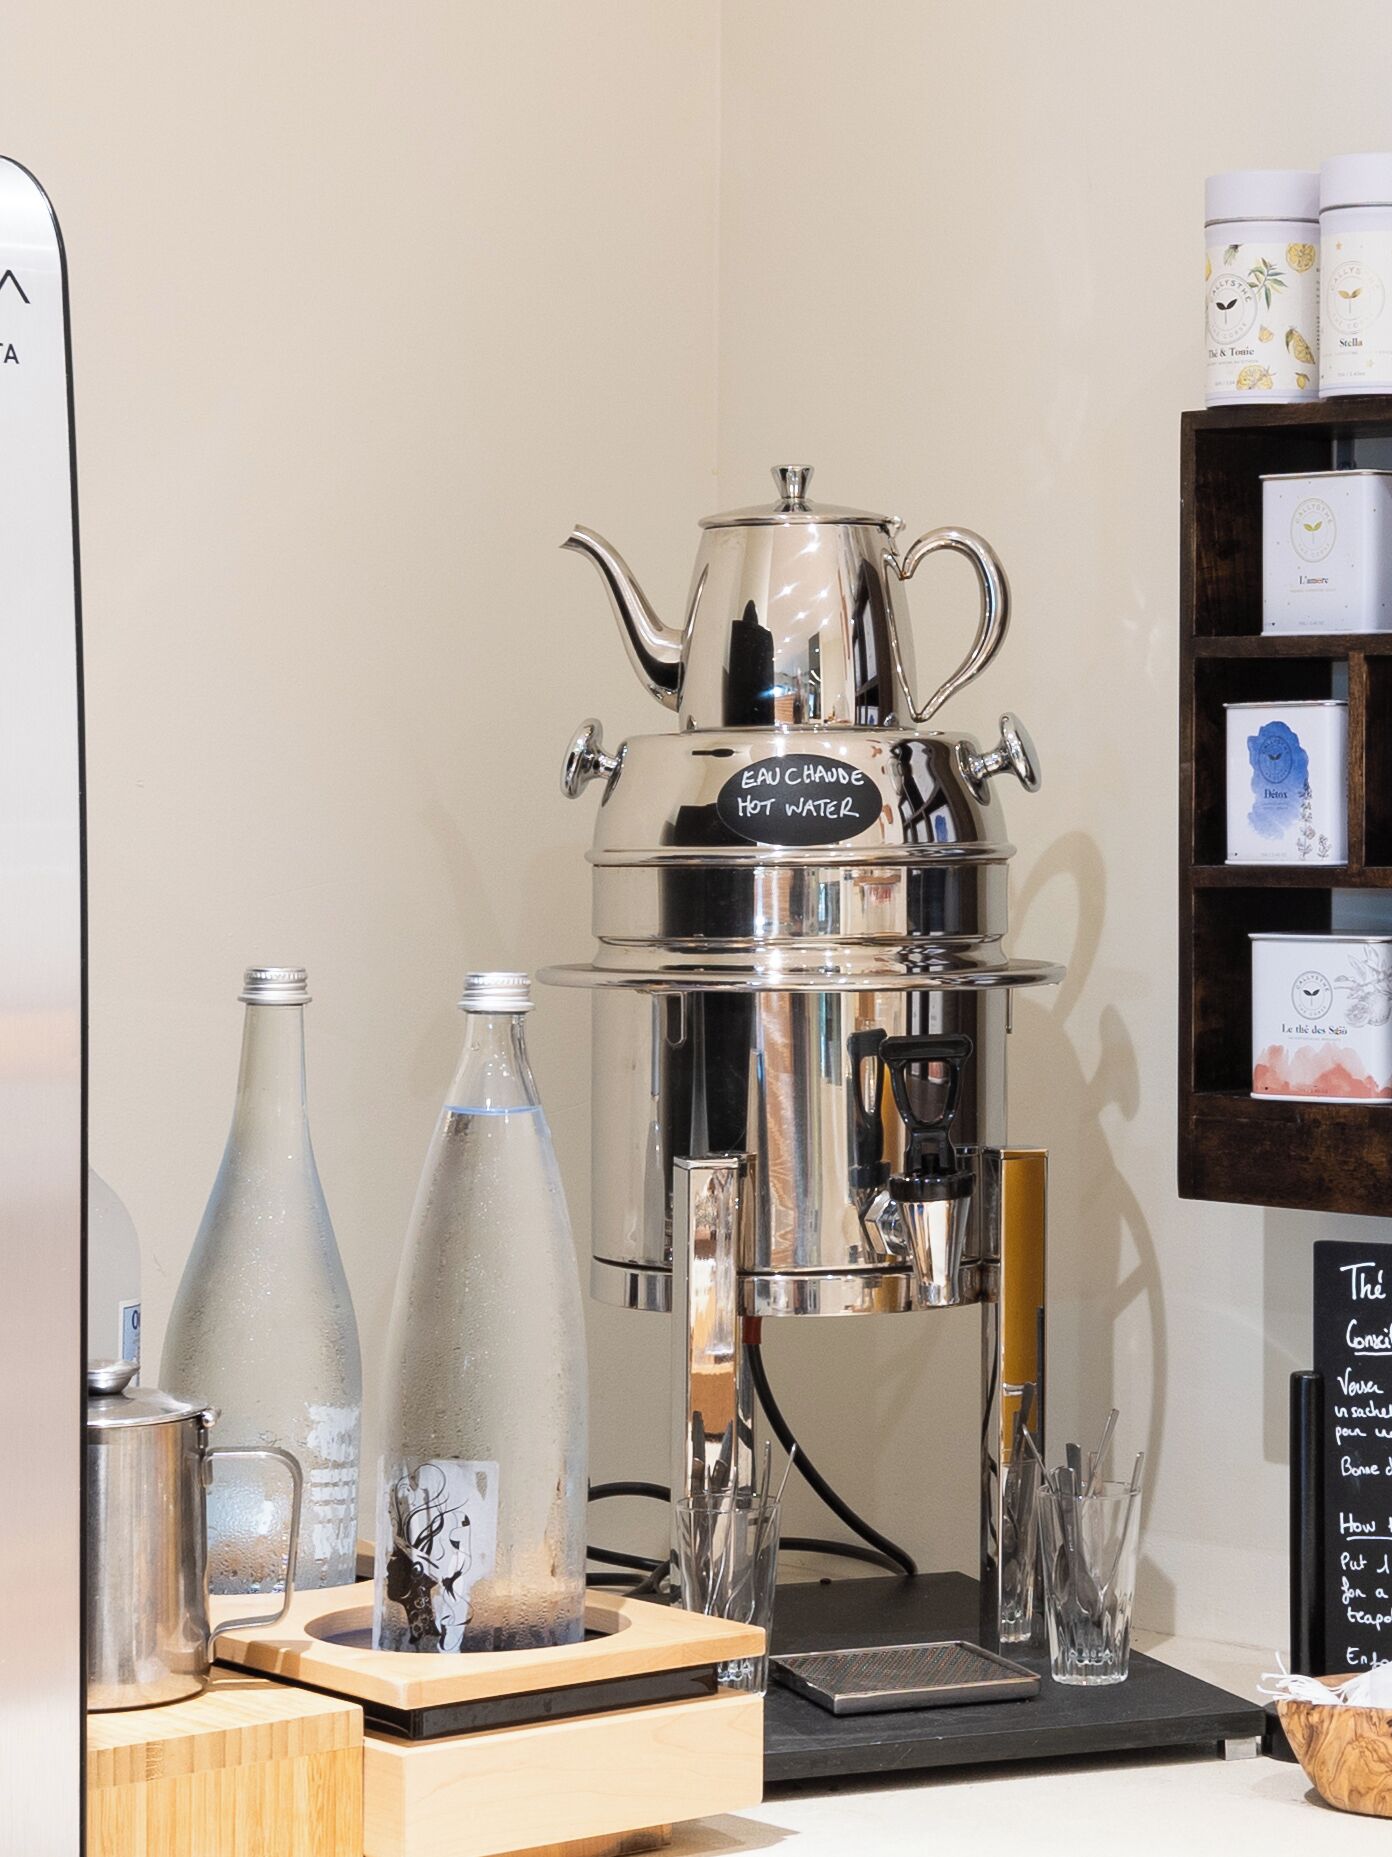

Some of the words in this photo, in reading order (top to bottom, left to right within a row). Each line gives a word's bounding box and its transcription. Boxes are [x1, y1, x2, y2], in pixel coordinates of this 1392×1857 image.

[0, 342, 20, 365] A
[1219, 347, 1226, 358] &
[1228, 346, 1255, 357] Tonic
[1338, 337, 1363, 348] Stella
[742, 767, 781, 788] EAU
[784, 764, 865, 786] CHAUDE
[1264, 788, 1288, 799] Détox
[737, 795, 776, 817] HOT
[785, 796, 860, 819] WATER
[1281, 1023, 1293, 1034] Le
[1295, 1023, 1310, 1035] thé
[1311, 1024, 1326, 1035] des
[1340, 1262, 1387, 1301] Thé
[1336, 1367, 1384, 1397] Verser
[1334, 1405, 1348, 1418] un
[1335, 1426, 1367, 1446] pour
[1341, 1456, 1380, 1477] Bonne
[1339, 1511, 1376, 1535] How
[1340, 1551, 1368, 1571] Put
[1376, 1553, 1390, 1575] 1
[1340, 1575, 1367, 1605] for
[1375, 1588, 1389, 1599] a
